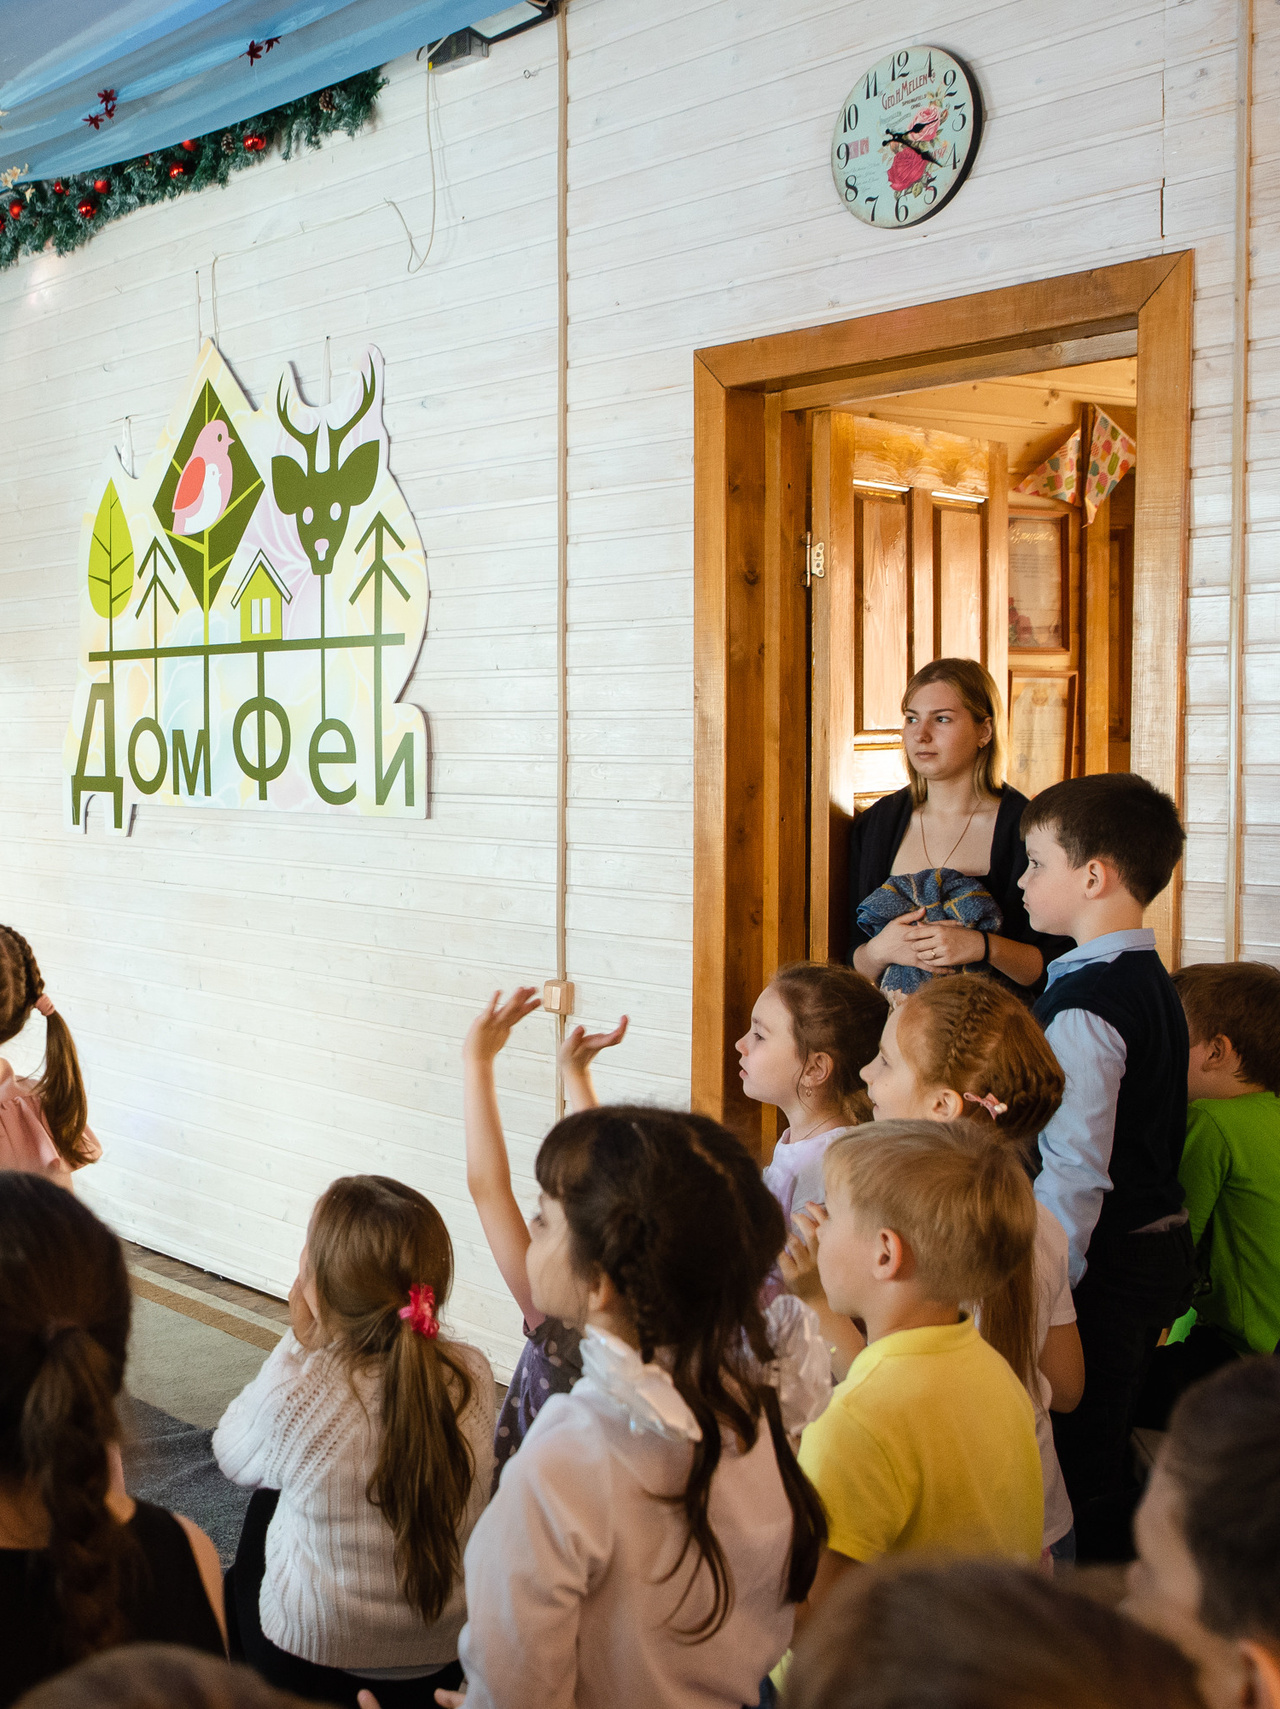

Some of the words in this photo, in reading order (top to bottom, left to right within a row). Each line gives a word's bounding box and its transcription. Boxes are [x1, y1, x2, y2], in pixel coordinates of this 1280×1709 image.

[888, 50, 910, 82] 12
[924, 50, 933, 78] 1
[863, 70, 878, 100] 11
[943, 69, 958, 98] 2
[839, 103, 859, 133] 10
[951, 102, 966, 132] 3
[836, 142, 850, 170] 9
[944, 143, 961, 170] 4
[844, 174, 859, 202] 8
[924, 175, 938, 205] 5
[864, 195, 880, 222] 7
[894, 195, 909, 222] 6
[71, 682, 212, 830] Дом
[232, 695, 415, 807] Феи
